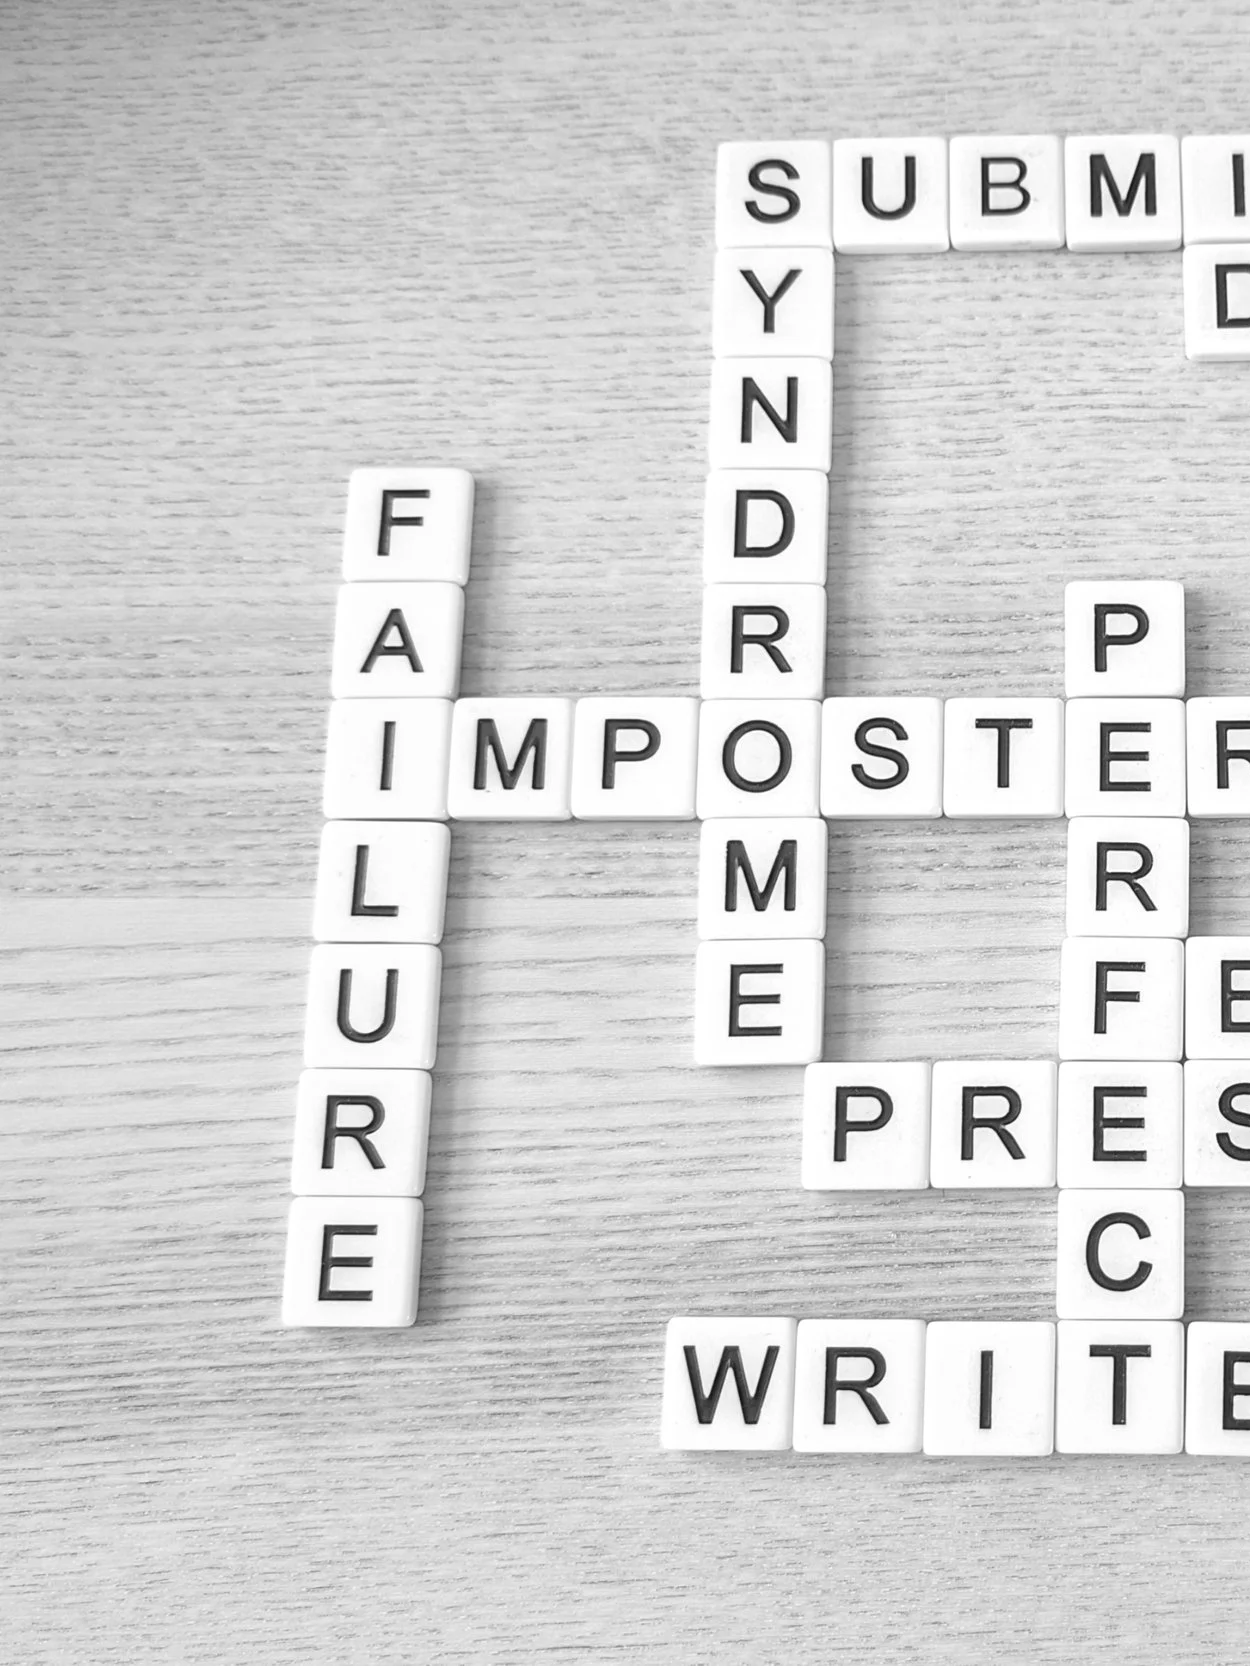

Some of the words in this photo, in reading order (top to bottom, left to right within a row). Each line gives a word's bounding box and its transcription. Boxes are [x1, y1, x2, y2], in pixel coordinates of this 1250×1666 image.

[318, 490, 429, 1301] FAILURE
[723, 160, 800, 1036] SYNDROME
[1086, 604, 1157, 1425] PERFECT
